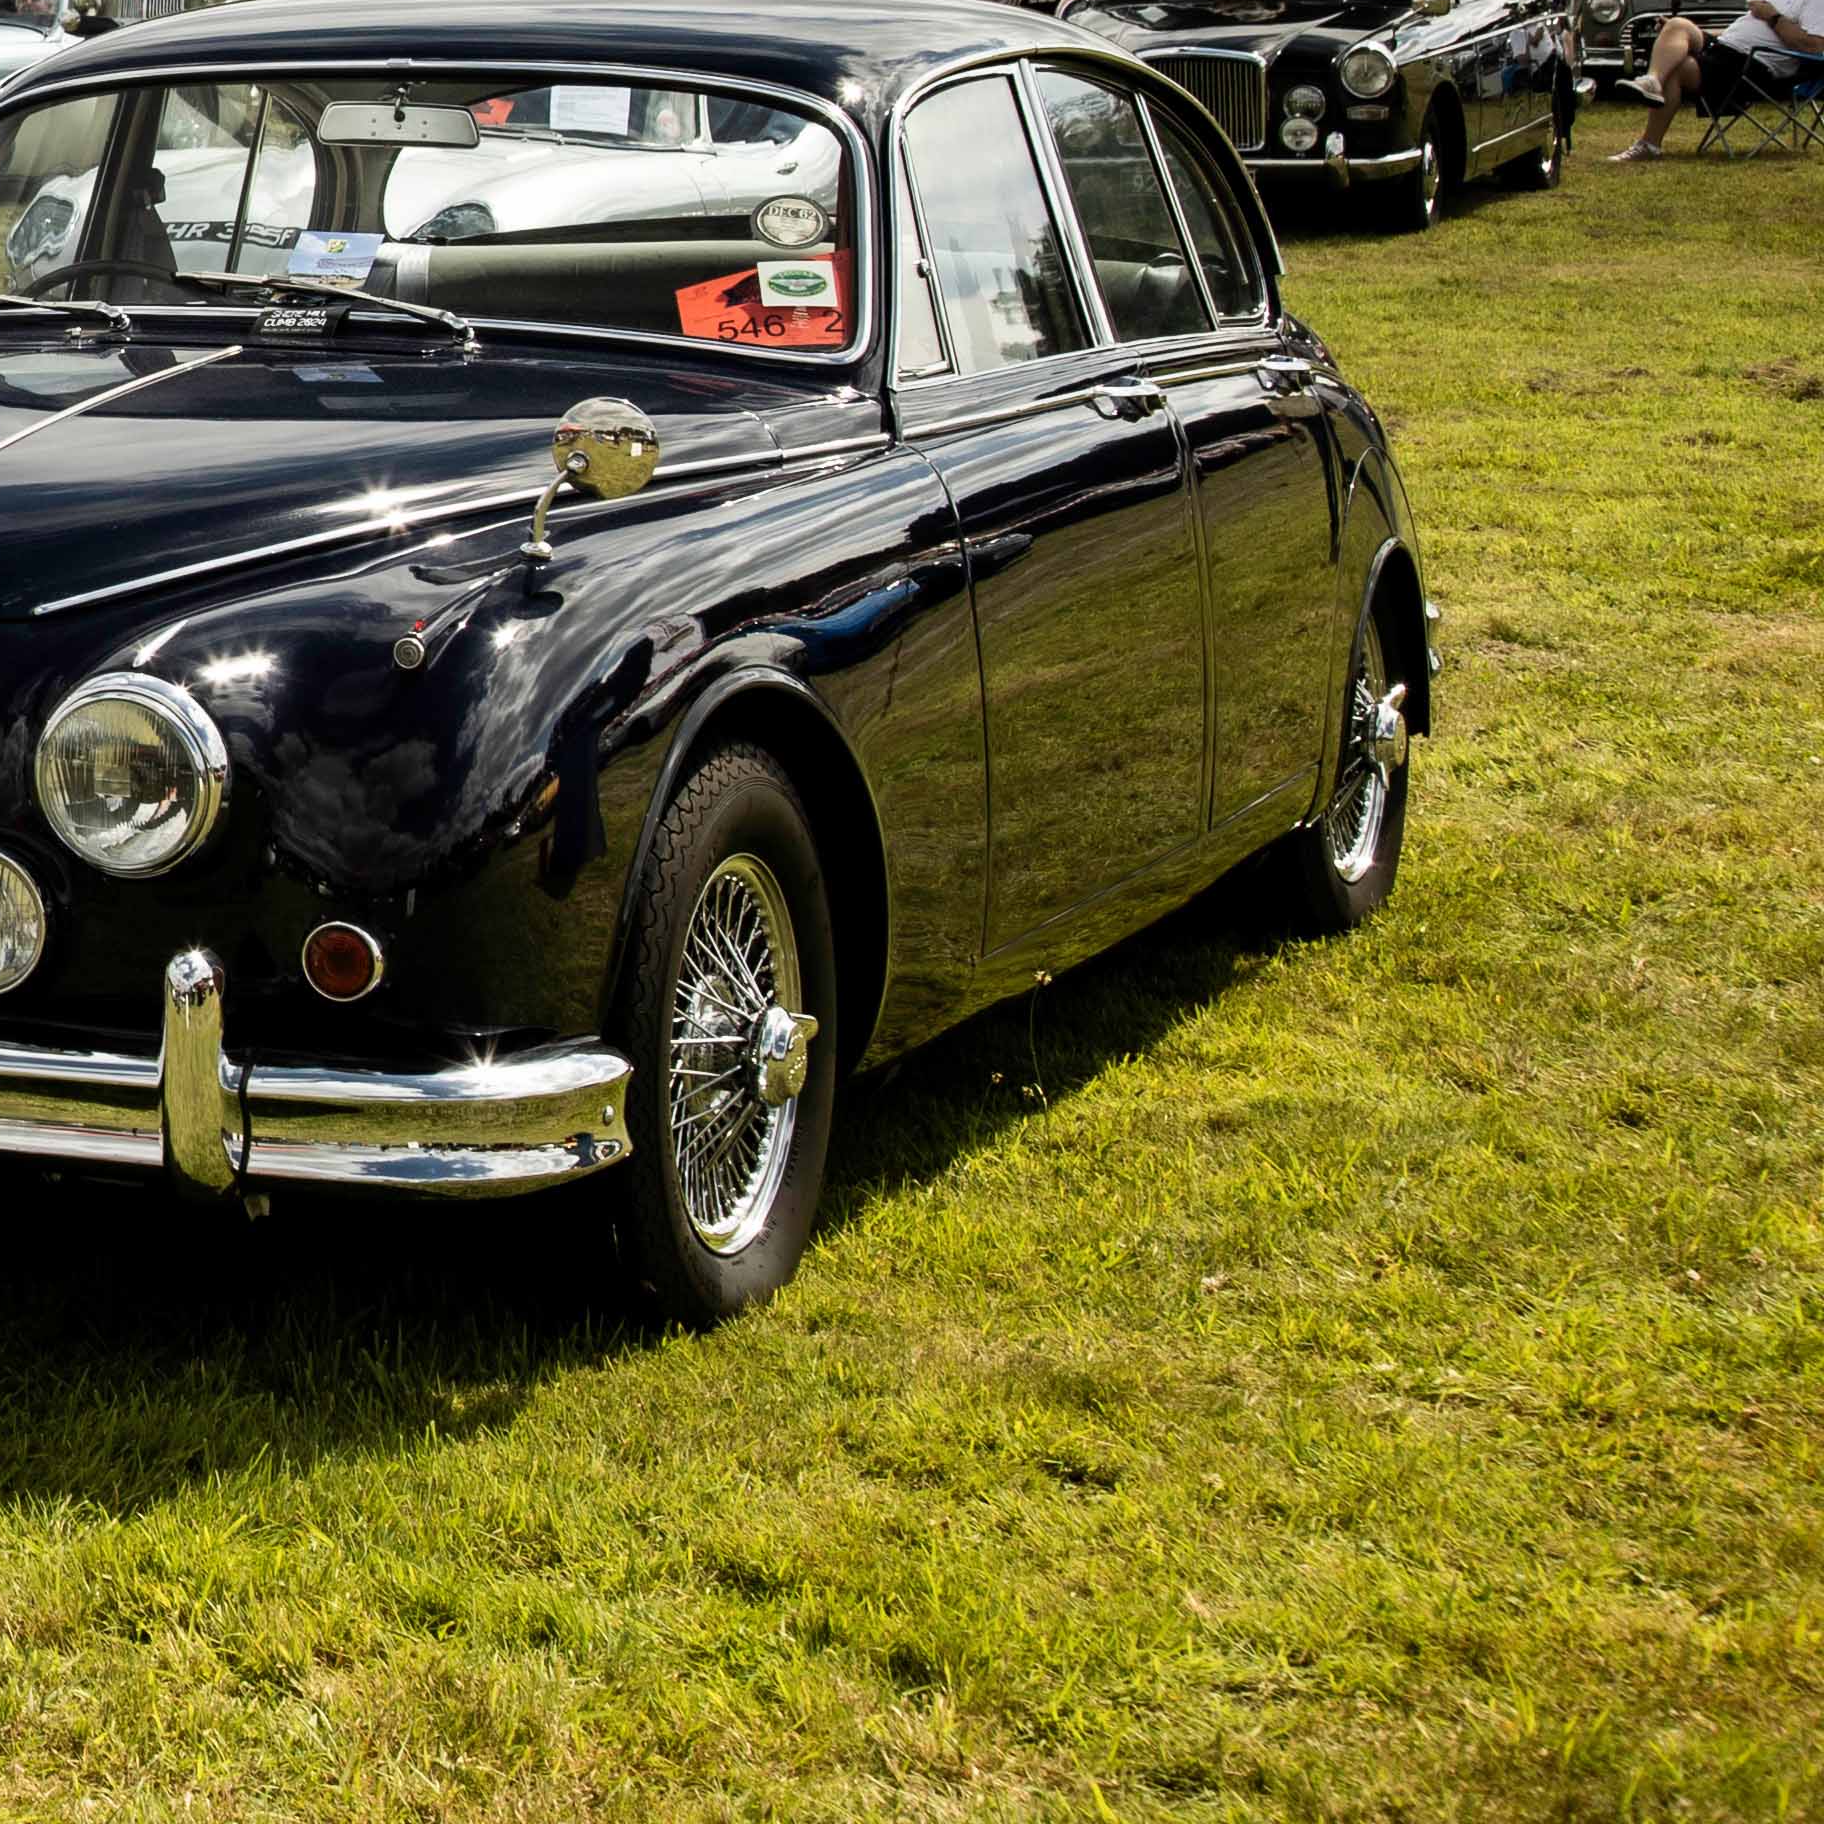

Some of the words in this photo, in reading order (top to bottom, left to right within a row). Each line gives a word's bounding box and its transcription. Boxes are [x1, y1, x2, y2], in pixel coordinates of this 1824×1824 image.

[768, 206, 798, 218] DEC
[263, 318, 297, 327] CLIMB
[717, 314, 786, 341] 546
